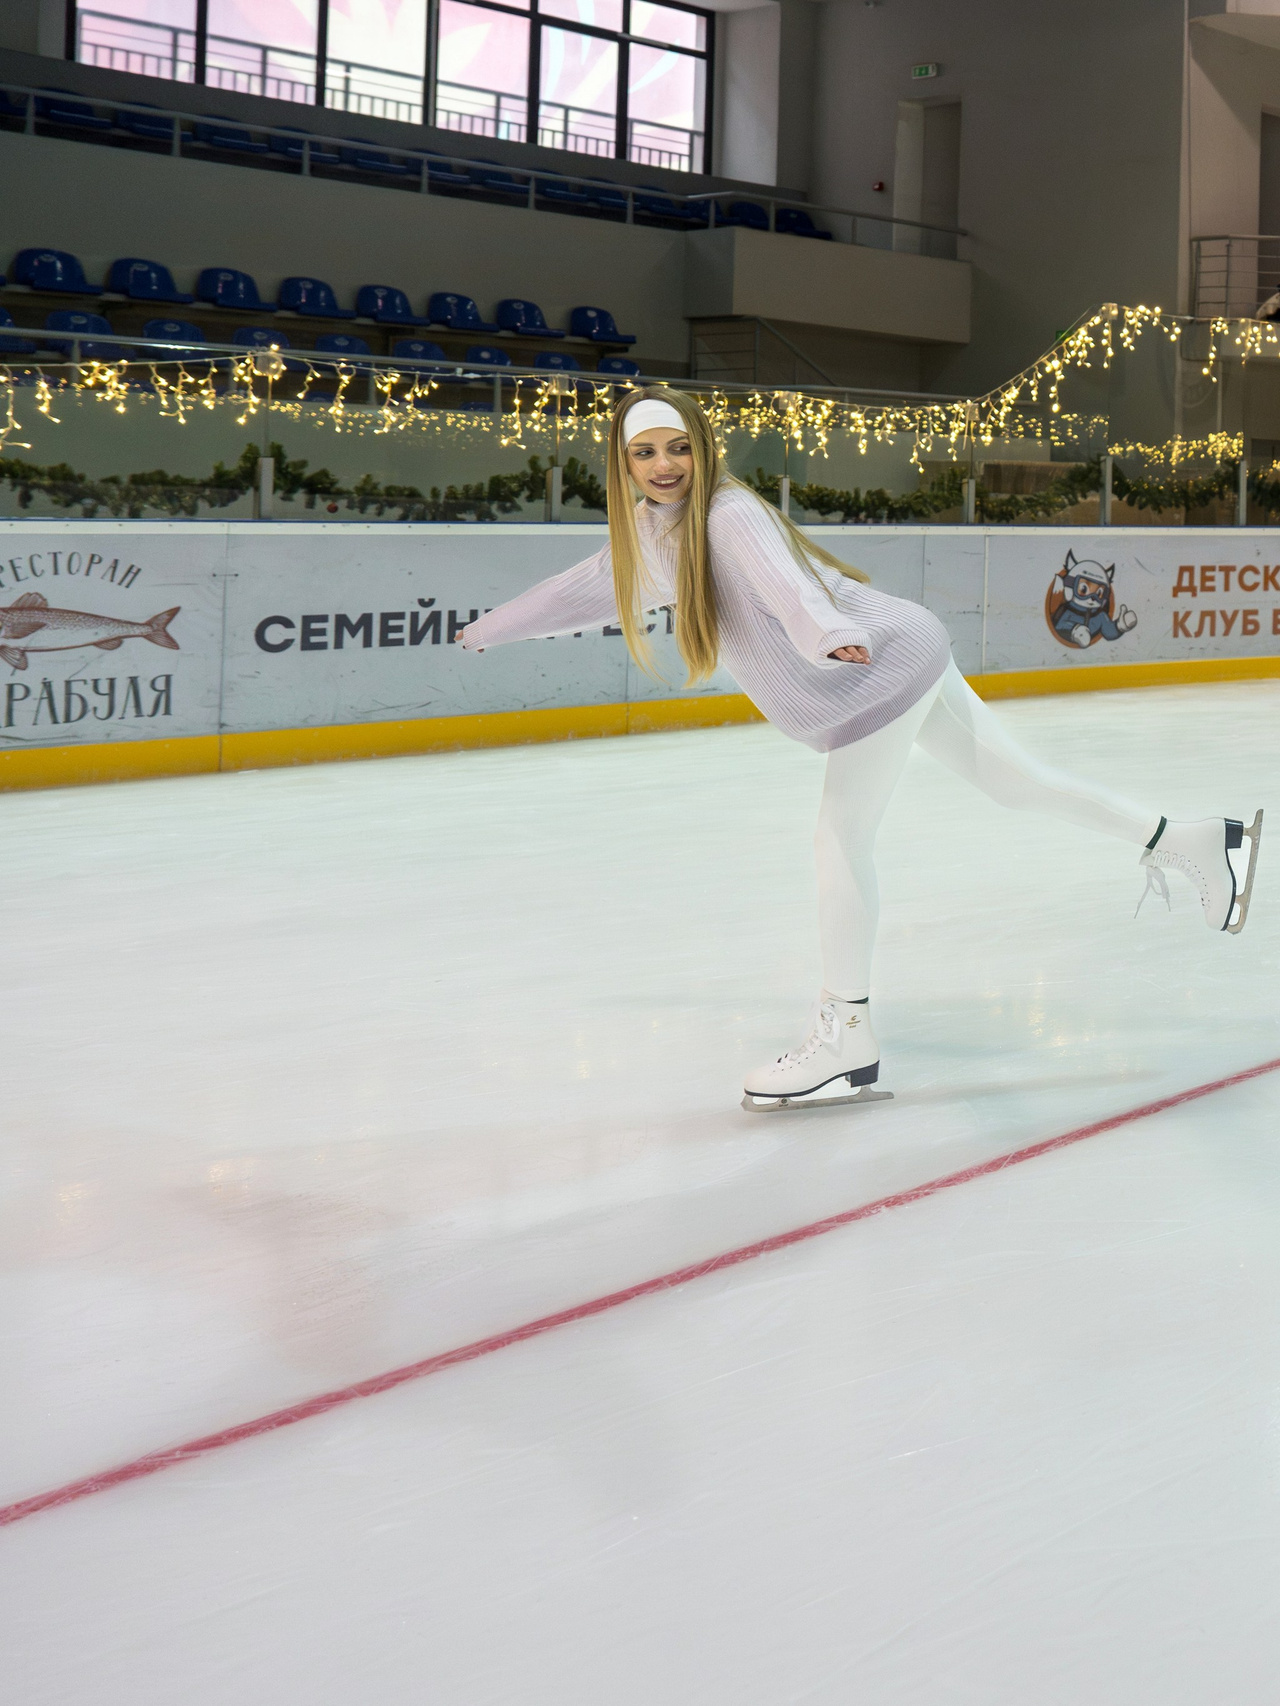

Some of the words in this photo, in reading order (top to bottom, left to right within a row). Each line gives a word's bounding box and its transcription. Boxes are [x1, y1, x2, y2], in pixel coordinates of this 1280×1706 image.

[254, 598, 490, 653] СЕМЕЙН
[1172, 608, 1261, 639] КЛУБ
[0, 674, 173, 728] РАБУЛЯ
